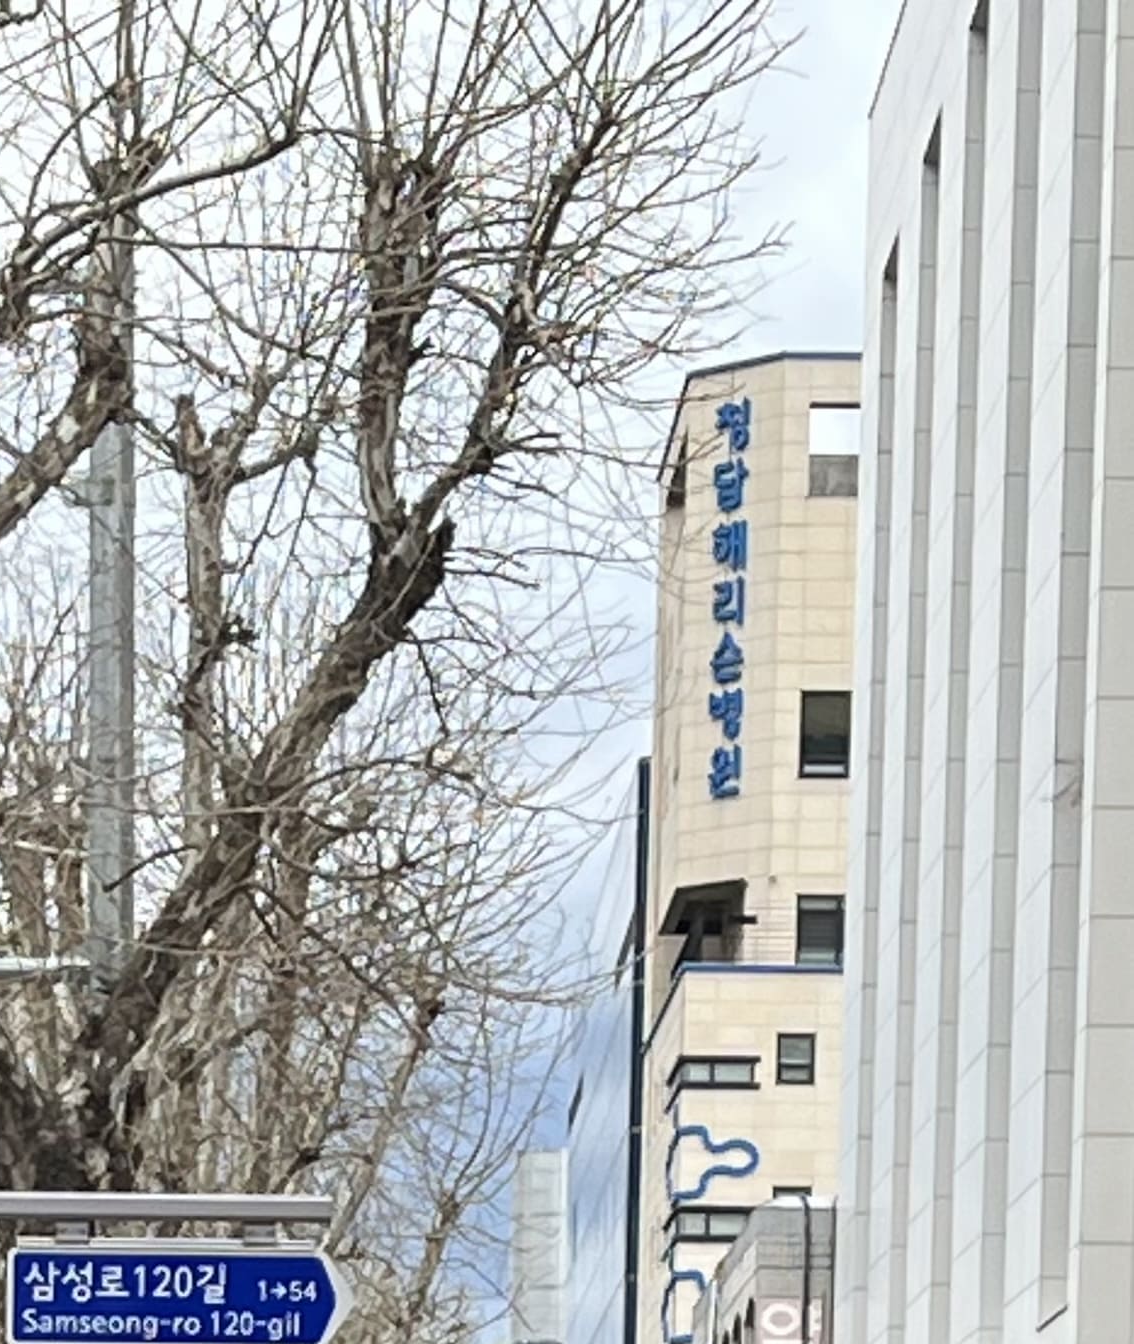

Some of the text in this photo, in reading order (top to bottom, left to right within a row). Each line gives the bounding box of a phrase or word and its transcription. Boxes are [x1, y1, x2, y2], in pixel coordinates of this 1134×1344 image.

[23, 1260, 228, 1305] 삼성로120길
[21, 1308, 301, 1341] Samseong-ro 120-gil
